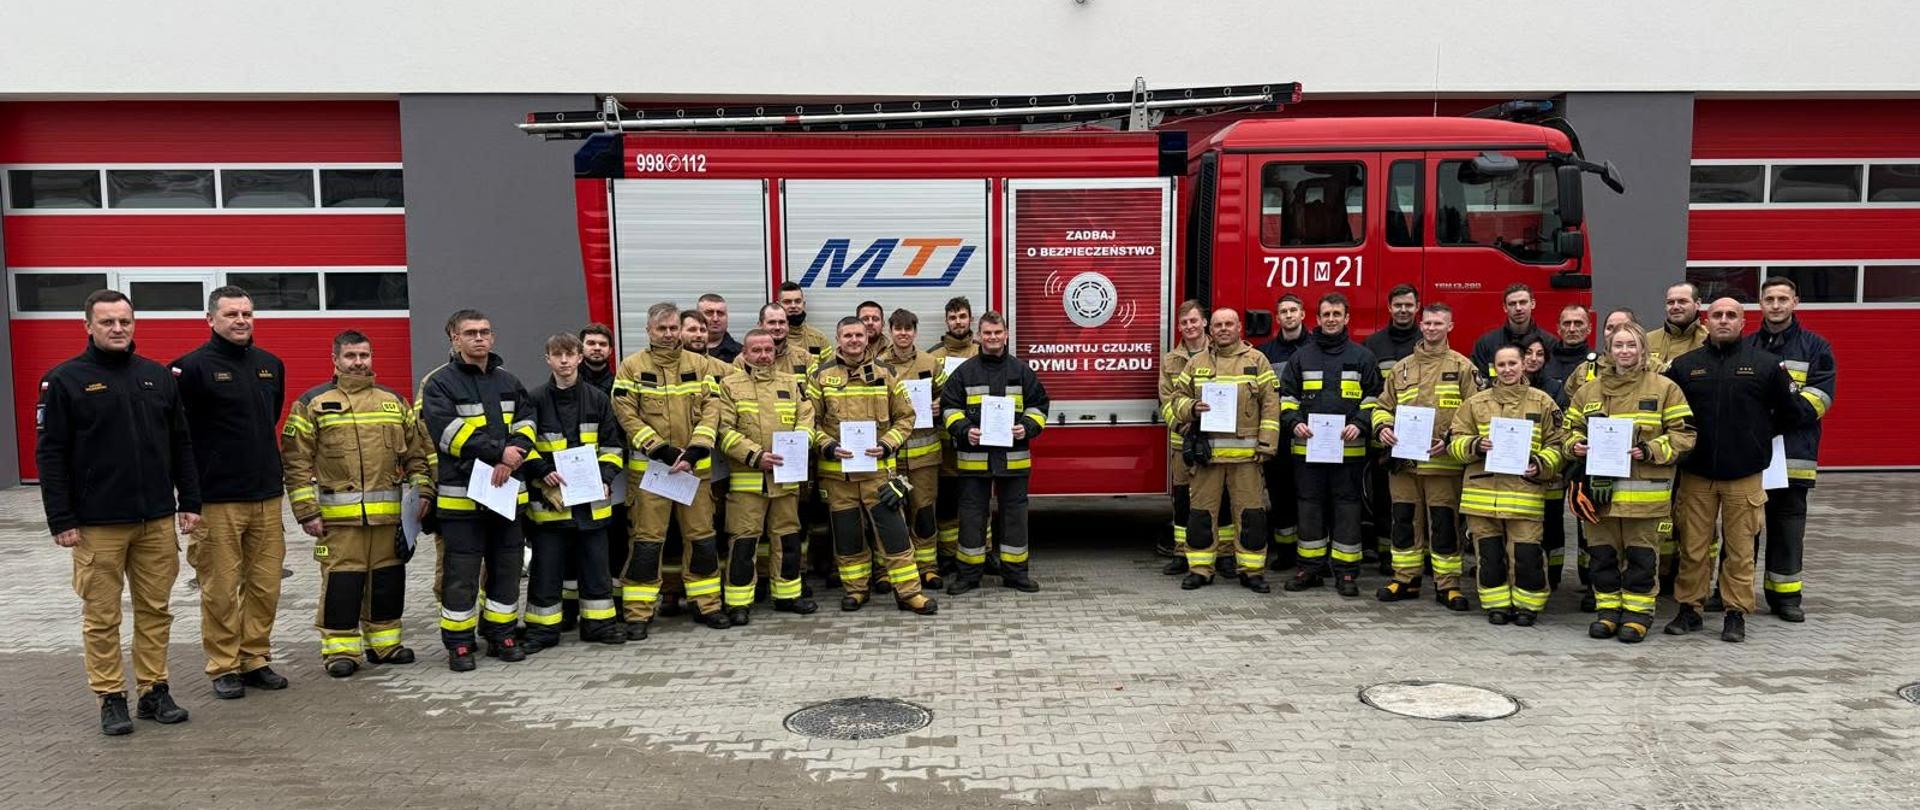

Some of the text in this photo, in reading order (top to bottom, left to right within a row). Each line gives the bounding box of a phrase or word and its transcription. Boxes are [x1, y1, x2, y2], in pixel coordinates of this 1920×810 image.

[636, 153, 707, 172] 998 112
[1065, 230, 1116, 241] ZADBAJ
[1027, 244, 1155, 257] O BEZPIECZEŃSTWO
[1263, 255, 1362, 287] 701 M 21
[1028, 343, 1153, 354] ZAMONTUJ CZUJKĘ
[1028, 358, 1153, 372] DYMU I CZADU
